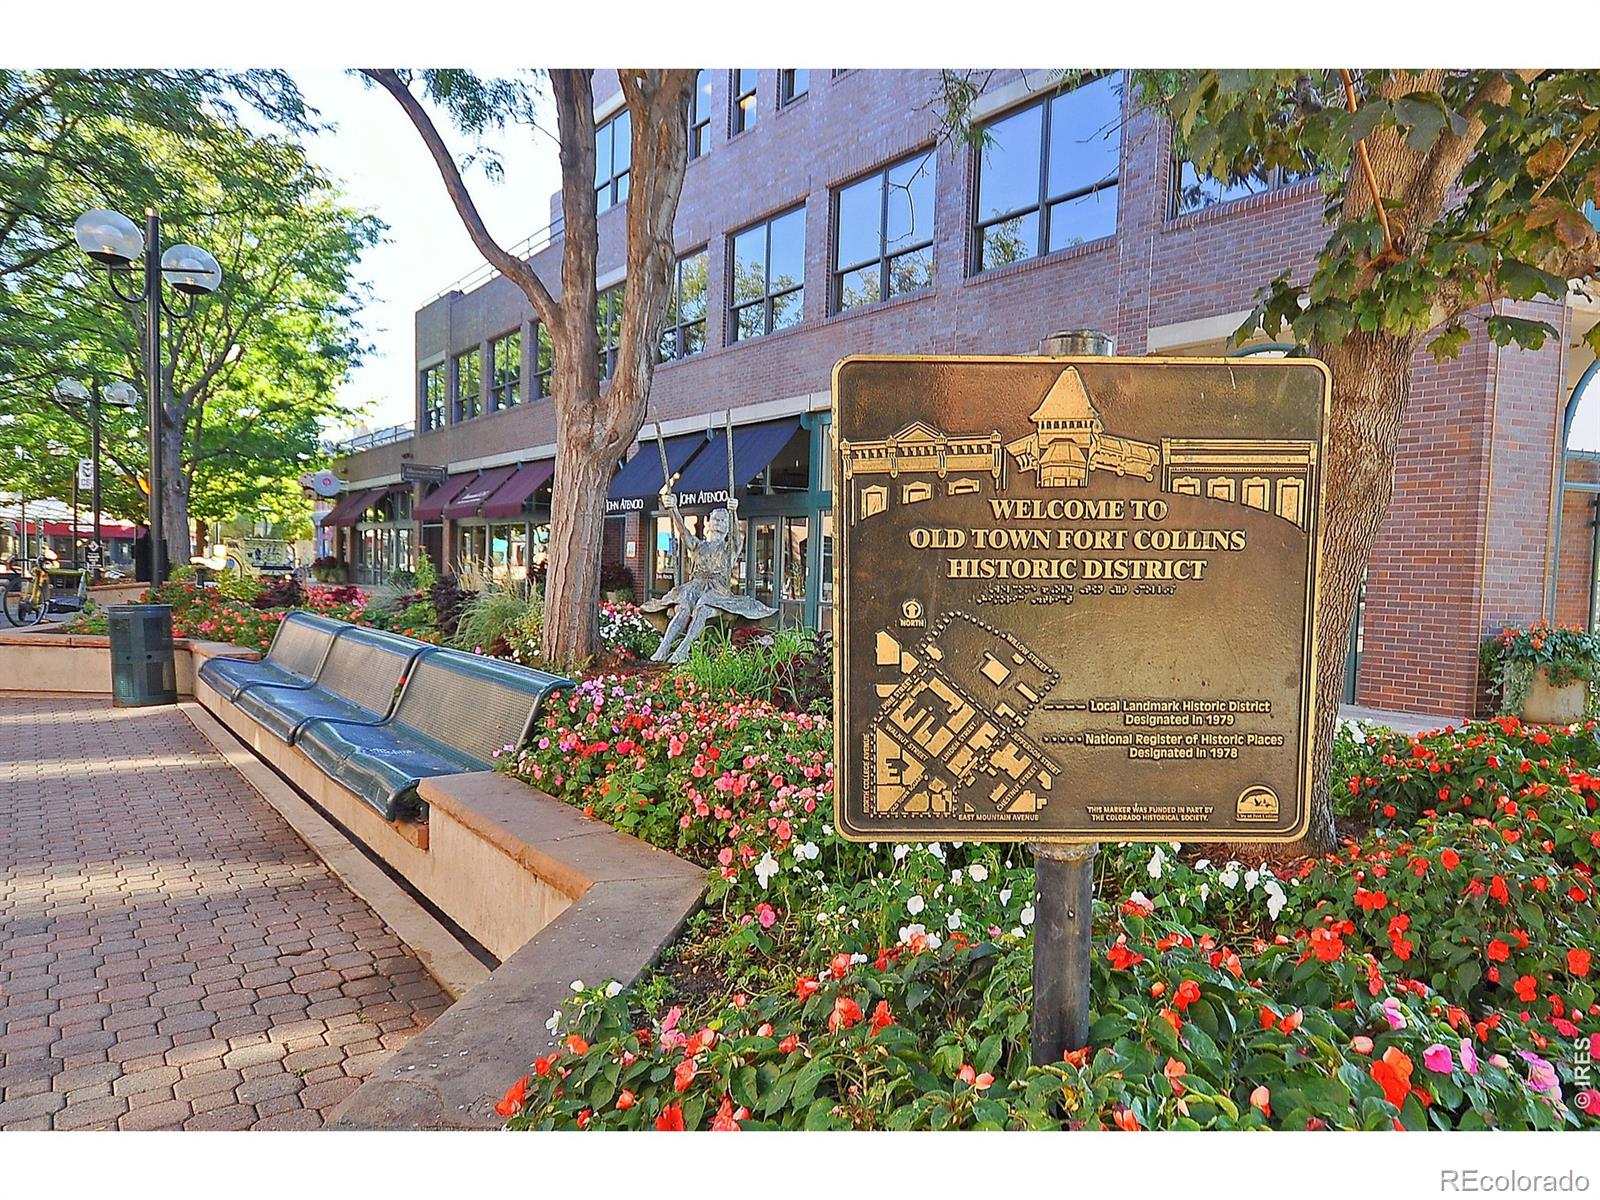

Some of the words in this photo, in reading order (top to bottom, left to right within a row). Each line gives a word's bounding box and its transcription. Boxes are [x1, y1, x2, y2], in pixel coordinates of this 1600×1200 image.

[680, 492, 697, 507] JOHN
[989, 499, 1124, 520] WELCOME
[1130, 500, 1168, 520] TO
[909, 528, 966, 549] OLD
[971, 528, 1050, 549] TOWN
[1057, 529, 1128, 550] FORT
[1133, 529, 1246, 550] COLLINS
[947, 558, 1077, 579] HISTORIC
[1081, 559, 1208, 580] DISTRICT
[900, 619, 924, 627] NORTH
[1006, 633, 1030, 656] WILLOW
[1027, 652, 1049, 672] STREET
[894, 677, 913, 698] STREET
[1090, 700, 1120, 711] Local
[1122, 700, 1180, 711] Landmark
[1182, 700, 1226, 711] Historic
[1228, 700, 1271, 712] District
[1125, 714, 1189, 726] Designated
[1206, 714, 1234, 725] 1979
[886, 724, 909, 746] WALNUT
[907, 742, 929, 762] STREET
[941, 740, 960, 762] LINDEN
[958, 721, 977, 742] STREET
[1085, 733, 1133, 745] National
[1135, 733, 1183, 746] Register
[1185, 734, 1199, 745] of
[1201, 734, 1244, 745] Historic
[1247, 734, 1283, 746] Places
[1011, 732, 1042, 759] JEFFERSON
[1040, 756, 1062, 776] STREET
[1129, 747, 1193, 759] Designated
[1210, 747, 1238, 758] 1978
[996, 783, 1021, 811] CHESTNUT
[1019, 764, 1038, 786] STREET
[1132, 805, 1148, 813] WAS
